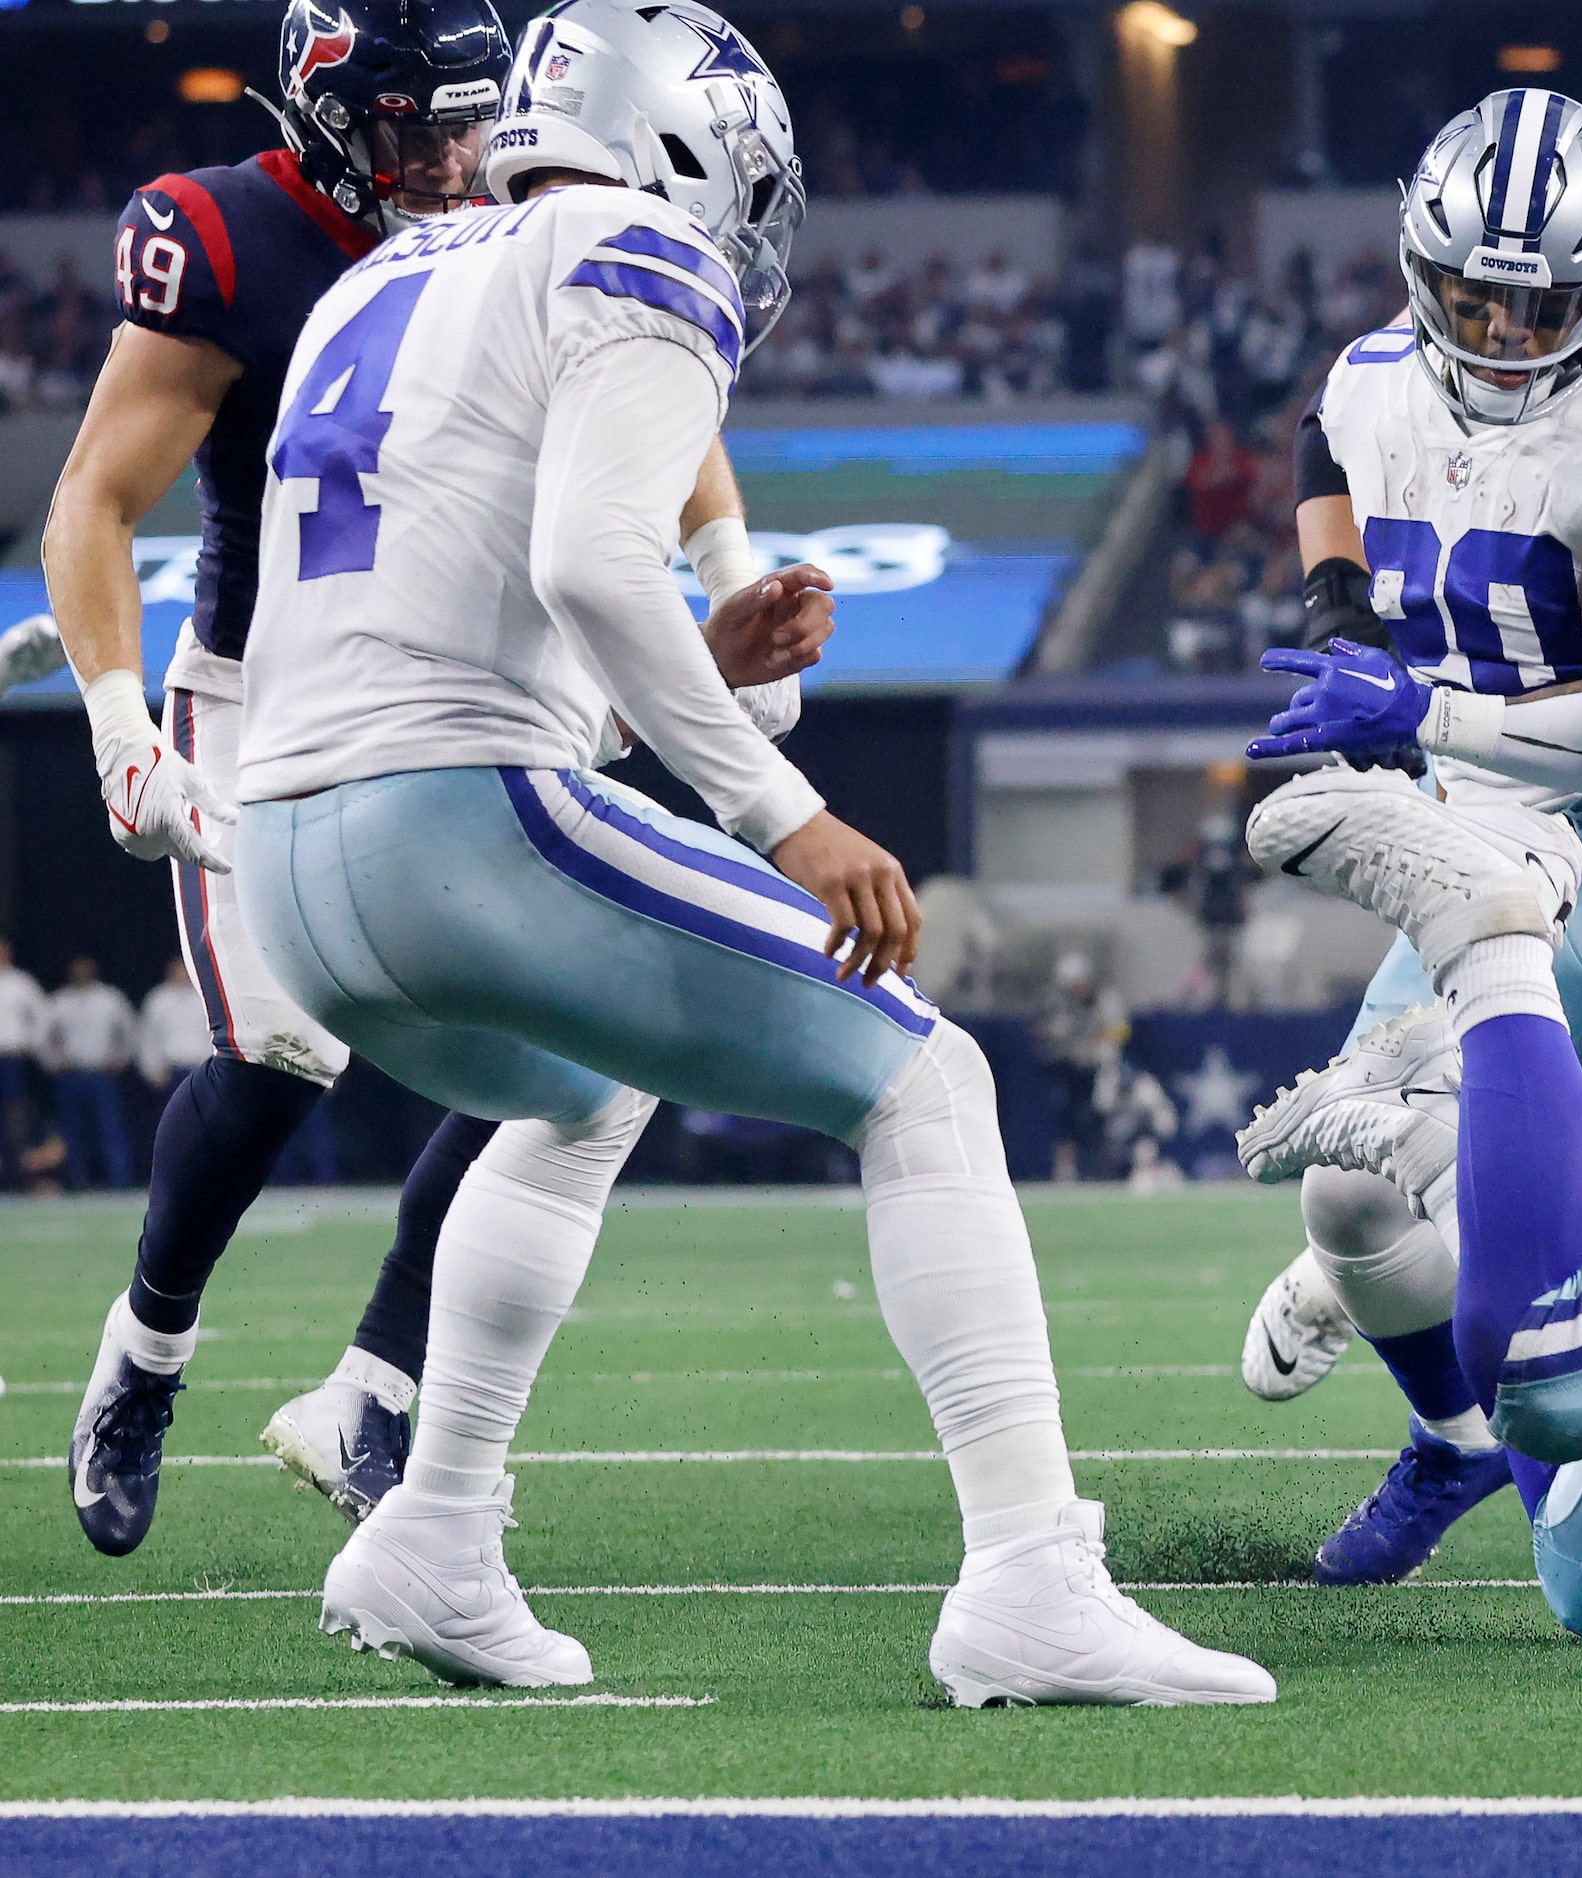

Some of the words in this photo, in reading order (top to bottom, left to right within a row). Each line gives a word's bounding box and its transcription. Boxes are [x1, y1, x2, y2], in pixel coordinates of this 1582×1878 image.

[446, 87, 490, 98] TEXANS
[114, 224, 189, 316] 49
[1481, 256, 1538, 274] COWBOYS
[272, 268, 435, 581] 4
